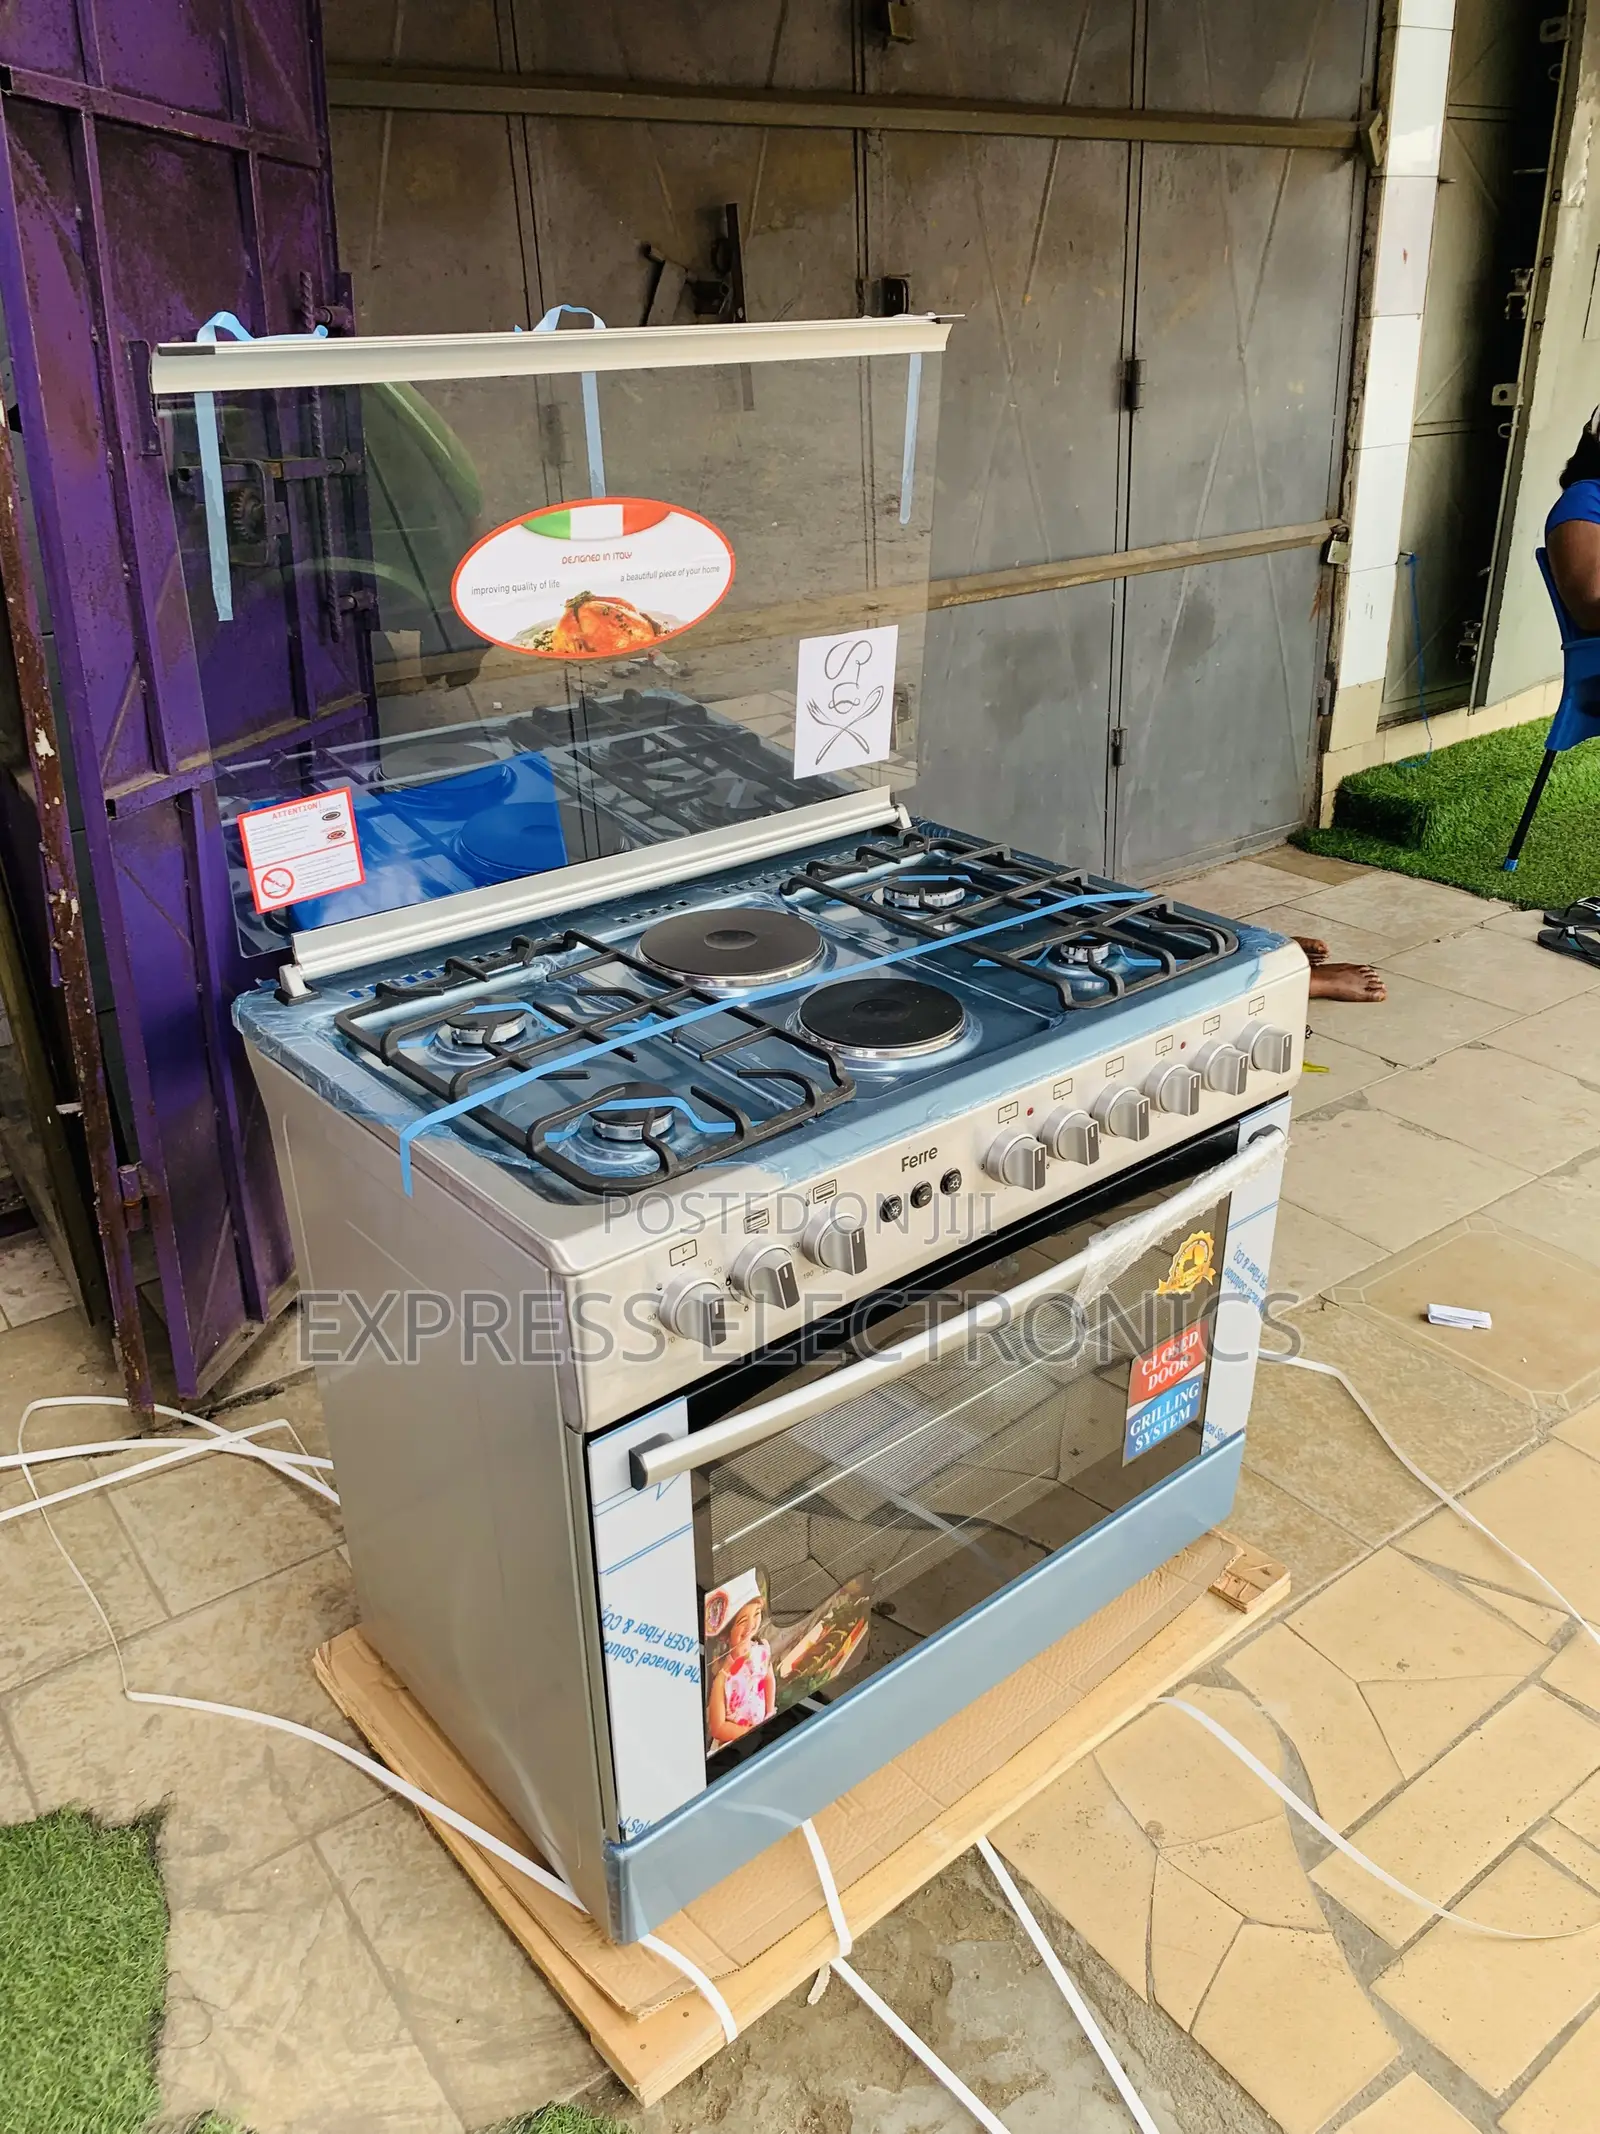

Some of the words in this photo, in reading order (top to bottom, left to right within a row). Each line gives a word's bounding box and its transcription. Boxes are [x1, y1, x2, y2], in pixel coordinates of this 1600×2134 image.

[561, 552, 601, 565] DESIGNED
[602, 552, 611, 562] IN
[612, 551, 633, 561] ITALY
[659, 568, 677, 581] piece
[678, 567, 685, 577] of
[685, 566, 701, 578] your
[702, 565, 720, 574] home
[471, 583, 510, 596] improving
[511, 582, 538, 594] quality
[539, 580, 548, 590] of
[548, 579, 560, 589] life
[271, 800, 322, 820] ATTENTION!
[901, 1146, 938, 1172] Ferre
[1141, 1331, 1199, 1376] CLOSED
[1148, 1352, 1190, 1391] DOOR
[1130, 1381, 1200, 1437] GRILLING
[1134, 1404, 1192, 1451] SYSTEM
[622, 1618, 635, 1634] &
[632, 1622, 666, 1645] Fiber
[635, 1652, 685, 1678] Novacel
[684, 1665, 701, 1684] The
